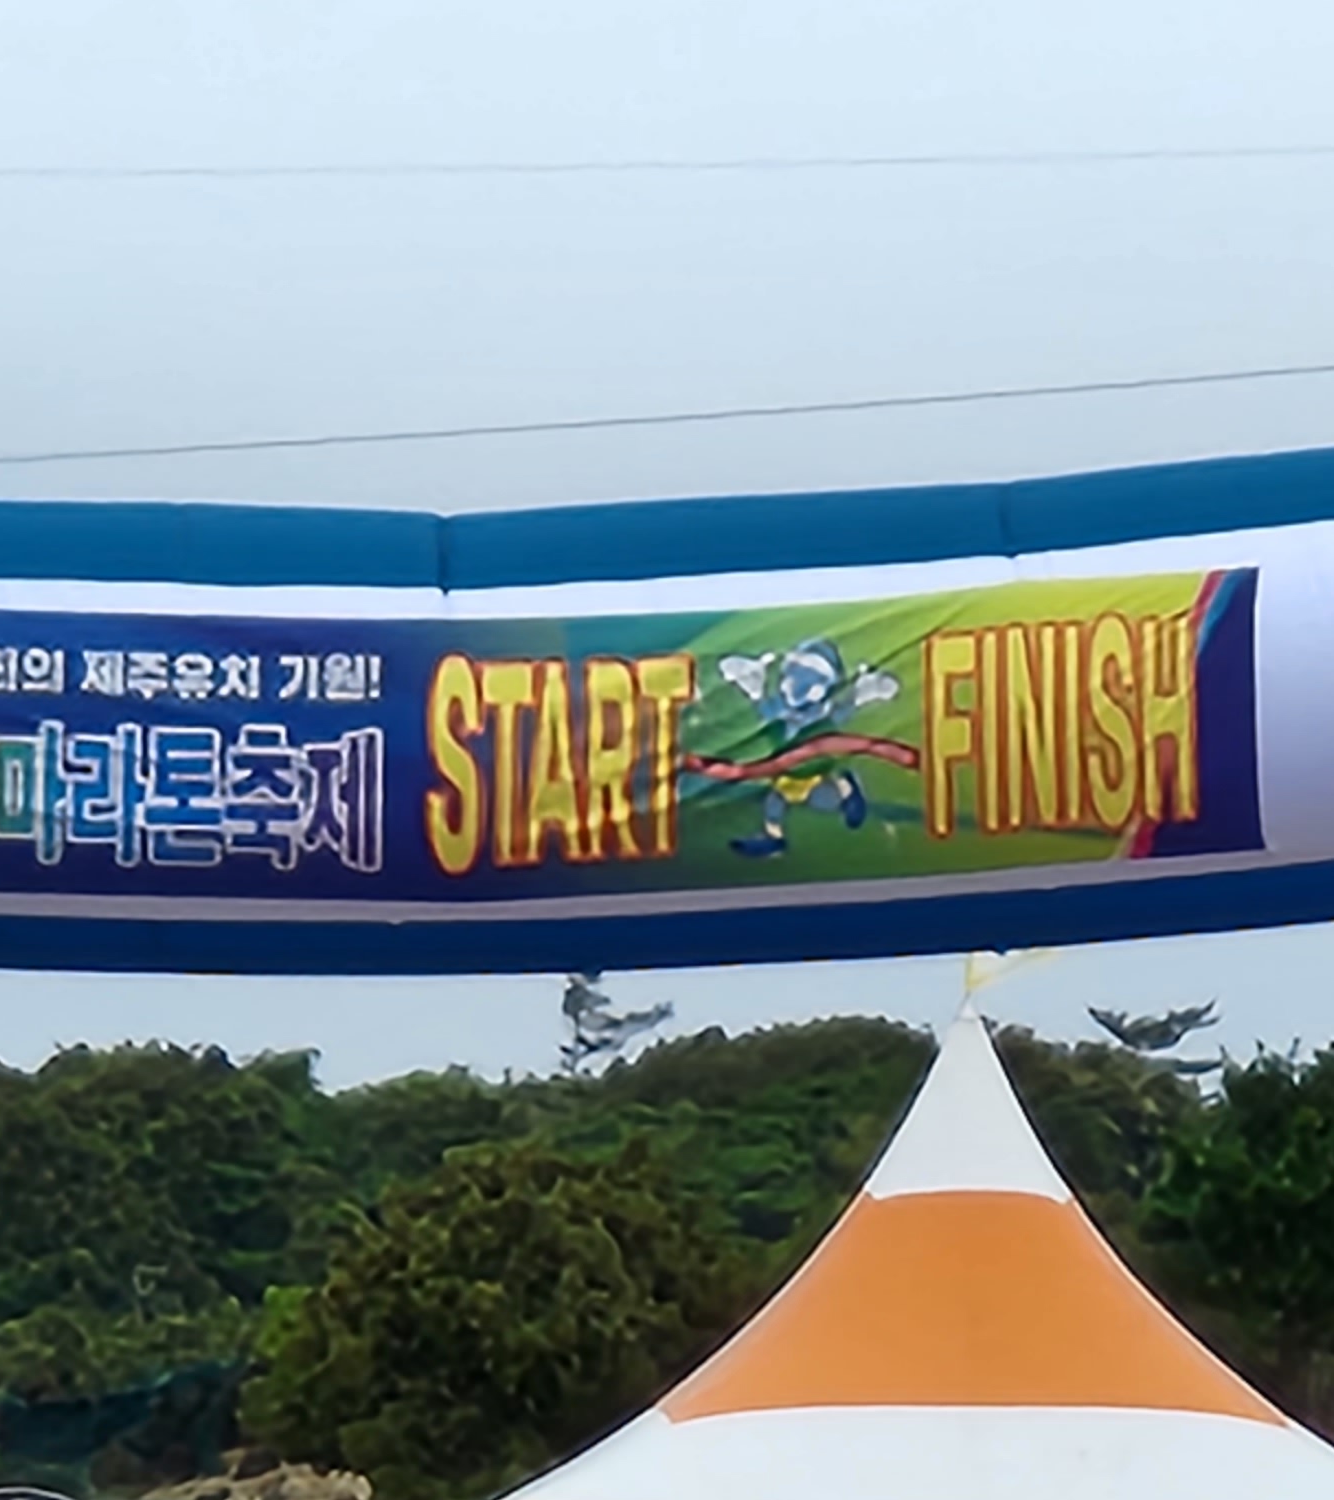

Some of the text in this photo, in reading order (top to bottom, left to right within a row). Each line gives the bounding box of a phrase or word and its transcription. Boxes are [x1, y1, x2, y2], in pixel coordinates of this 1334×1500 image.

[80, 649, 260, 700] 제주유치
[277, 652, 382, 700] 기원!
[424, 652, 696, 876] START
[920, 612, 1200, 840] FINISH
